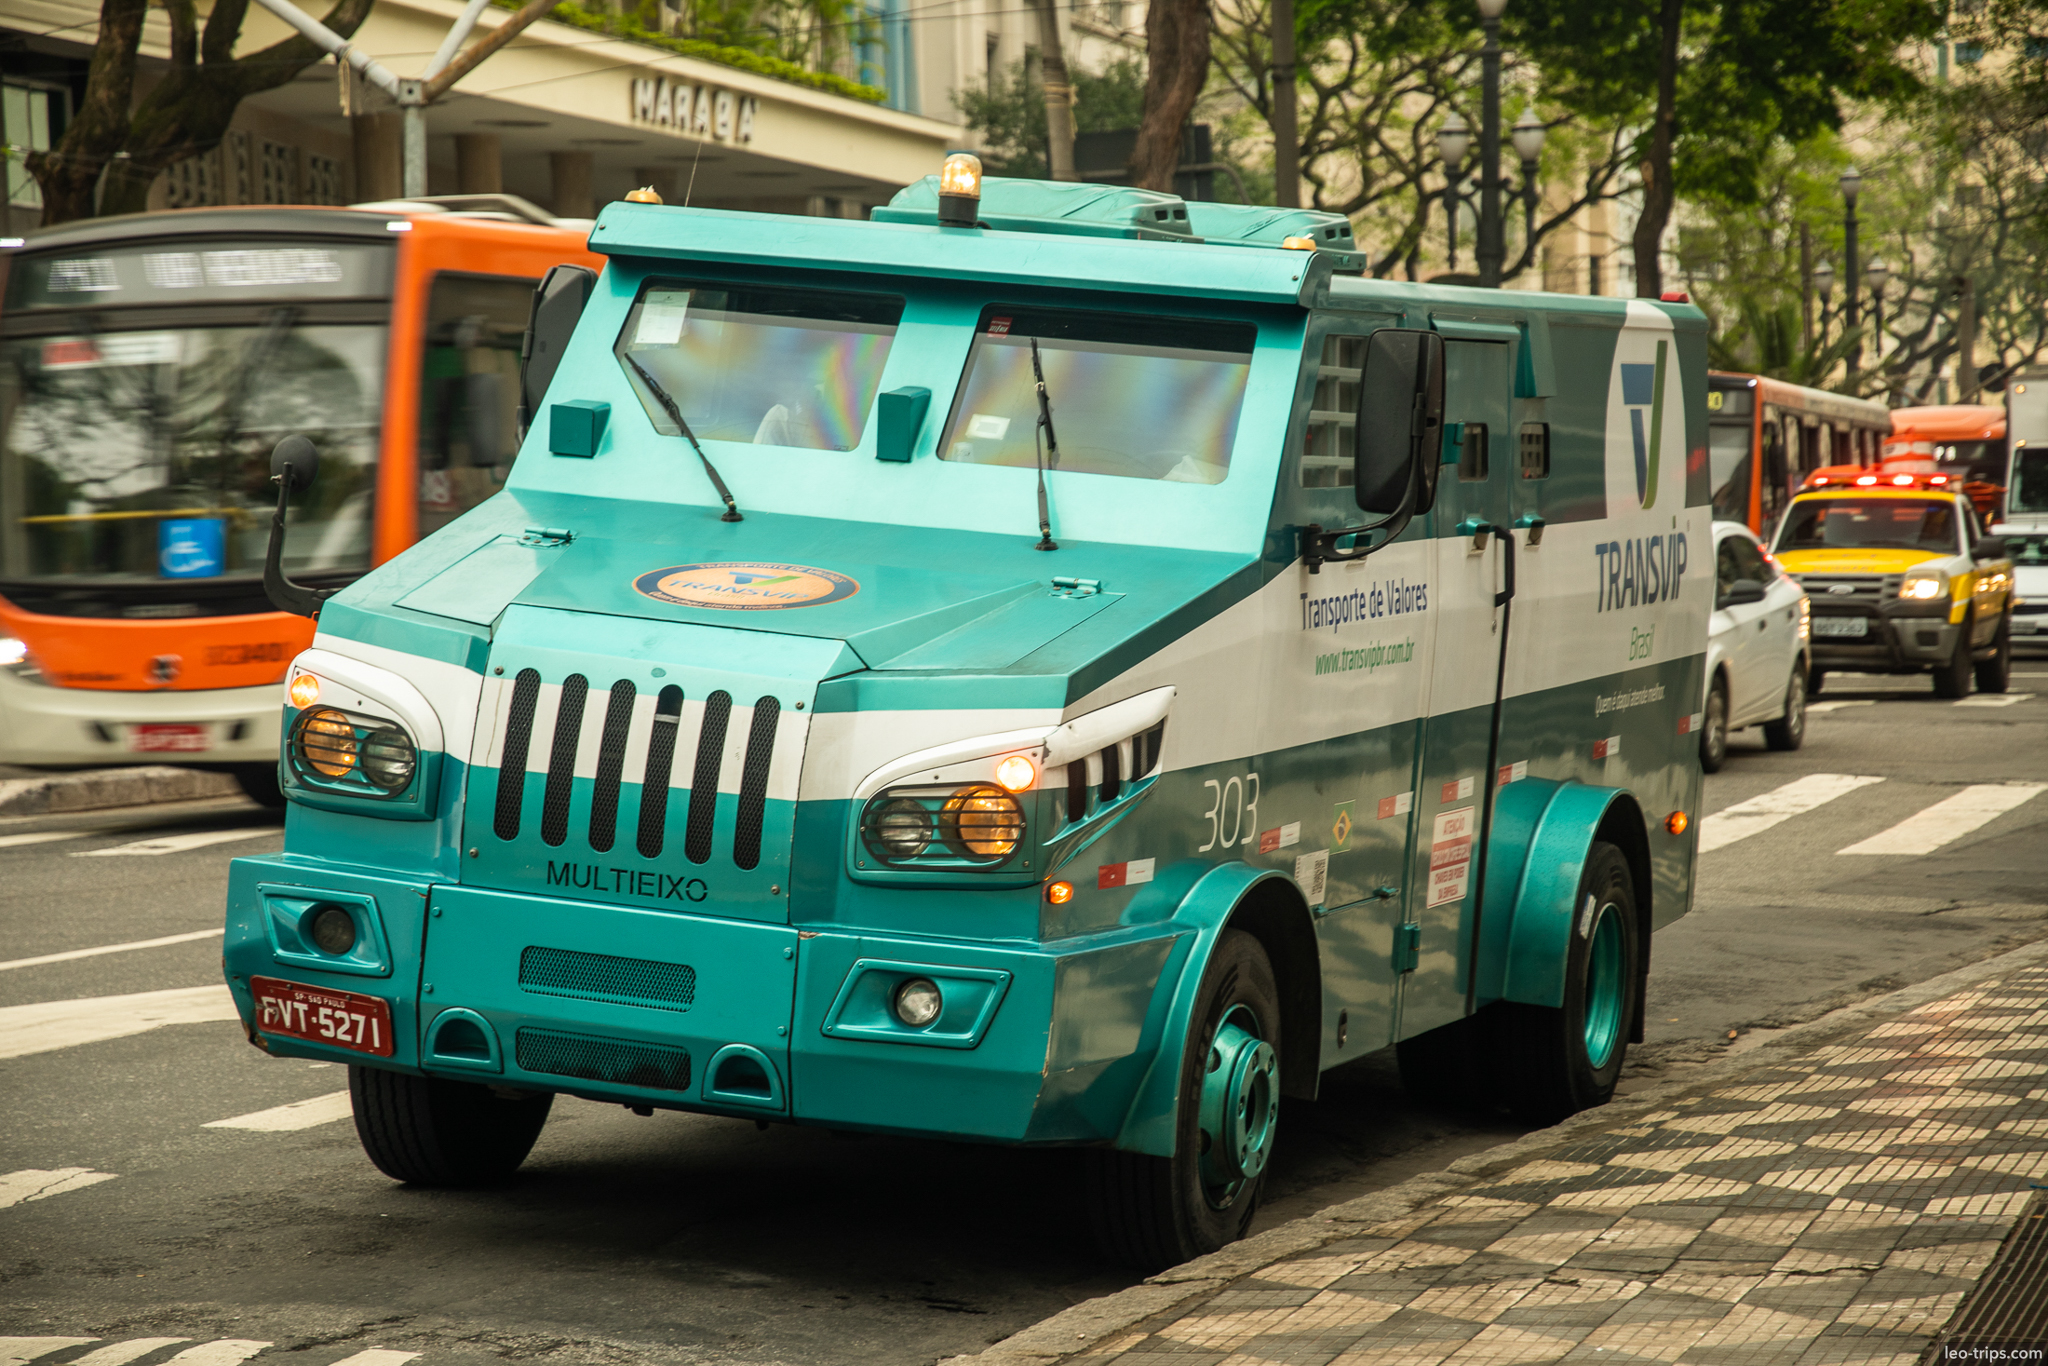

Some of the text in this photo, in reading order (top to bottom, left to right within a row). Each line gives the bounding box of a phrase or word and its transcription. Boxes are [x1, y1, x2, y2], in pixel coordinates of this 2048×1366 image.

[1300, 577, 1428, 634] Transporte de Valores
[1315, 636, 1415, 676] www.transvipbr.com.br
[1629, 623, 1655, 661] Brasil
[1595, 694, 1612, 718] Quem
[1198, 772, 1260, 853] 303
[546, 860, 708, 903] MULTIEIXO
[323, 997, 346, 1009] PAULO
